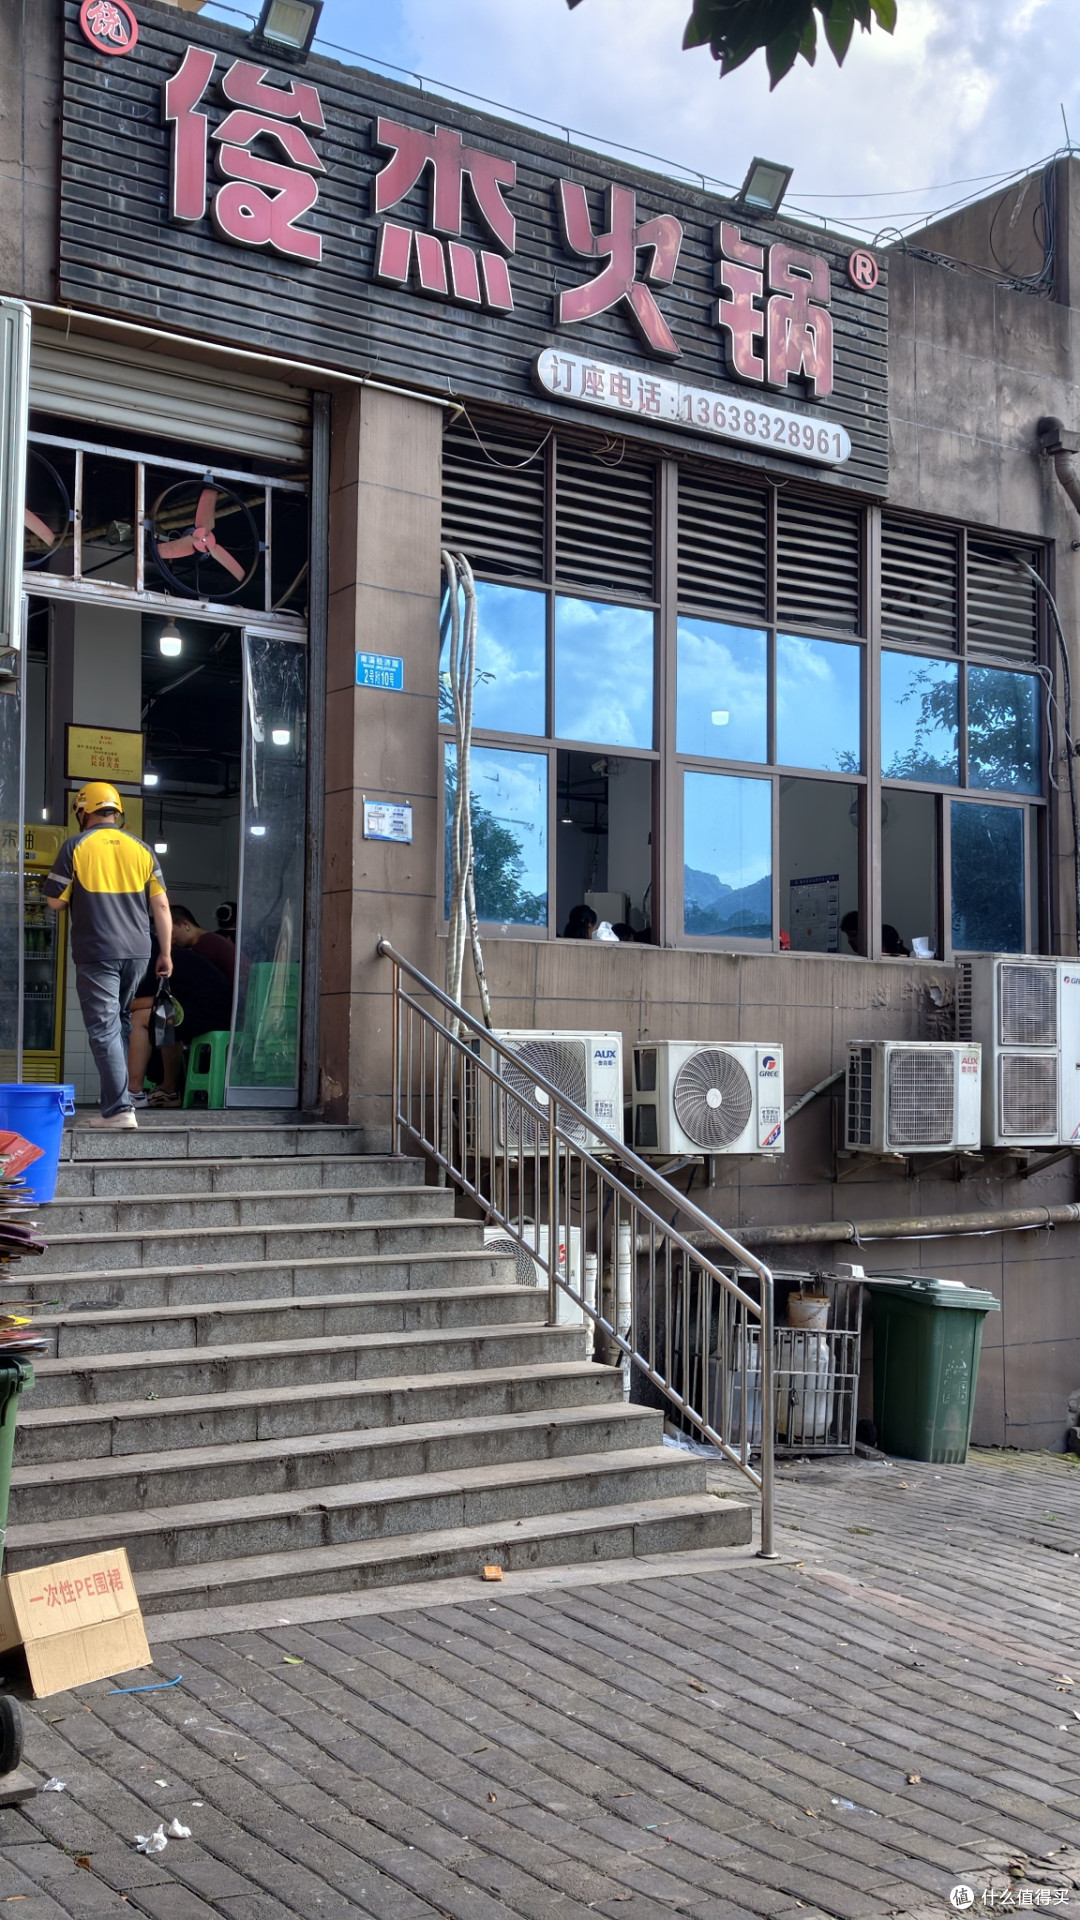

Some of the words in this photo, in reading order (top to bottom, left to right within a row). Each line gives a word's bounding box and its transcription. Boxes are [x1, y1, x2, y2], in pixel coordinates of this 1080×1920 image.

[165, 45, 833, 400] 俊杰火锅
[594, 1050, 616, 1059] AUX
[29, 1568, 124, 1608] 一次性PE围裙
